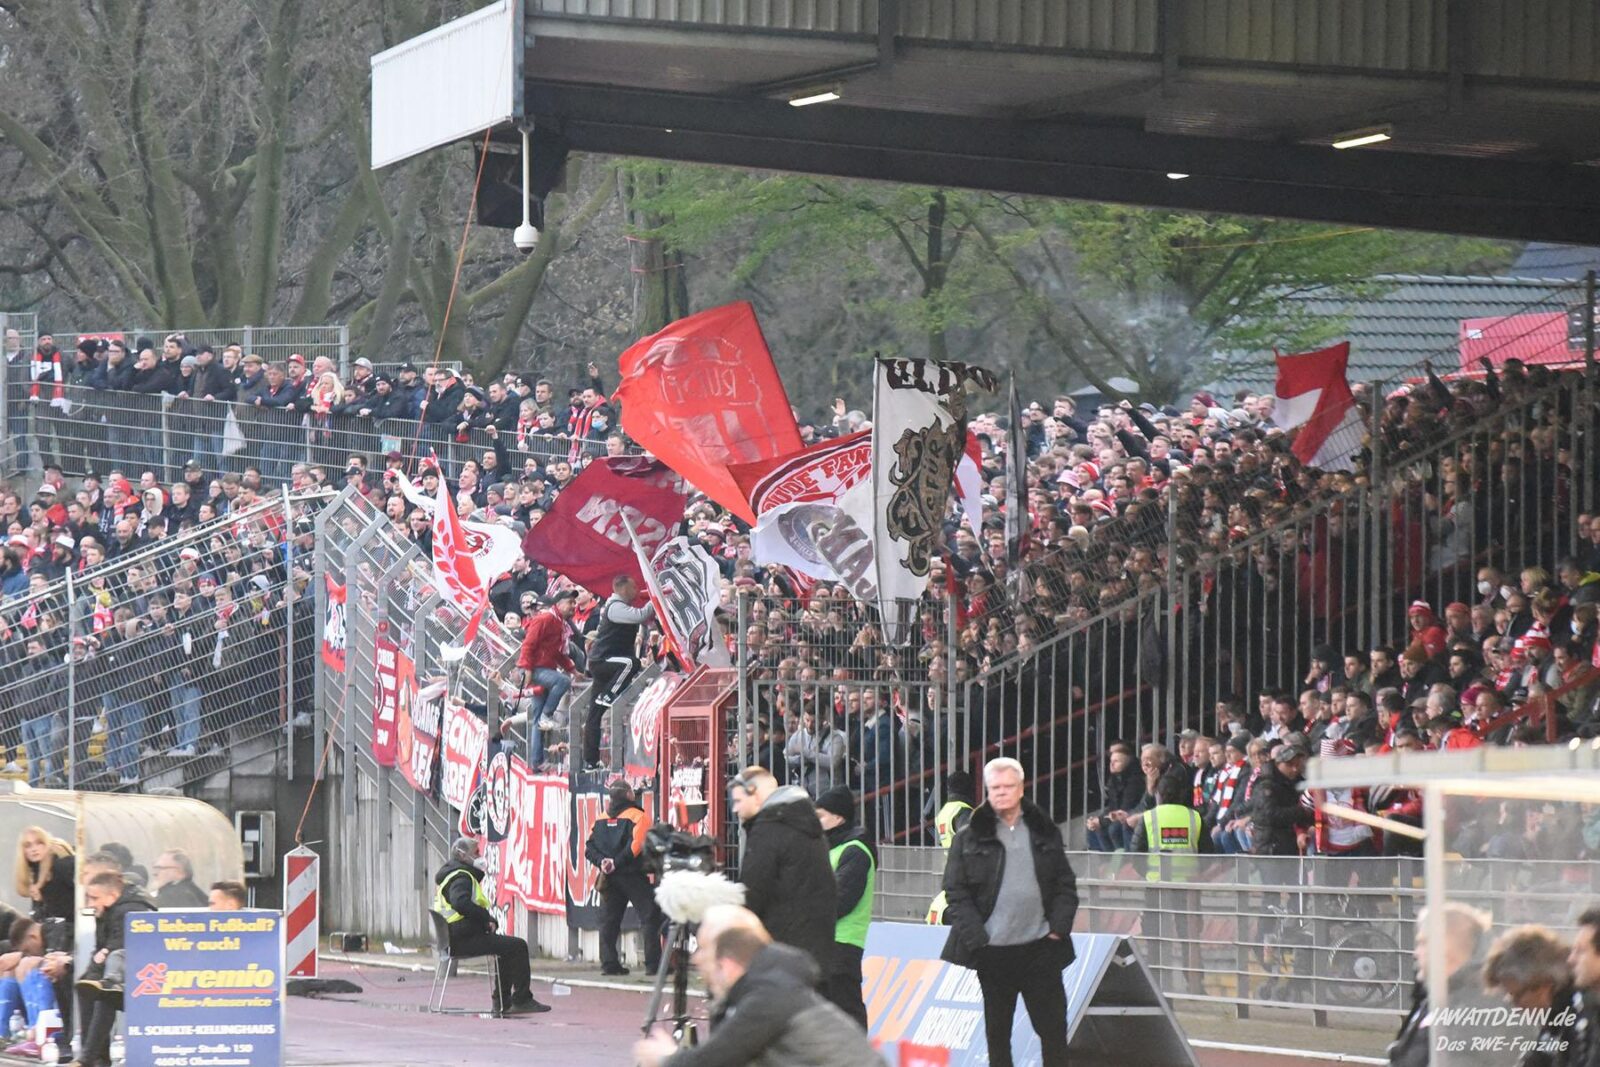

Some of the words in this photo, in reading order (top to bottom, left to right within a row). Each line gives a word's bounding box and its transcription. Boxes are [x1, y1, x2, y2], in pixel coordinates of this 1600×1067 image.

[130, 920, 155, 933] Sie
[158, 919, 206, 932] lieben
[210, 918, 276, 932] Fußball?
[164, 938, 194, 950] Wir
[197, 937, 241, 950] auch!
[162, 963, 275, 995] premio
